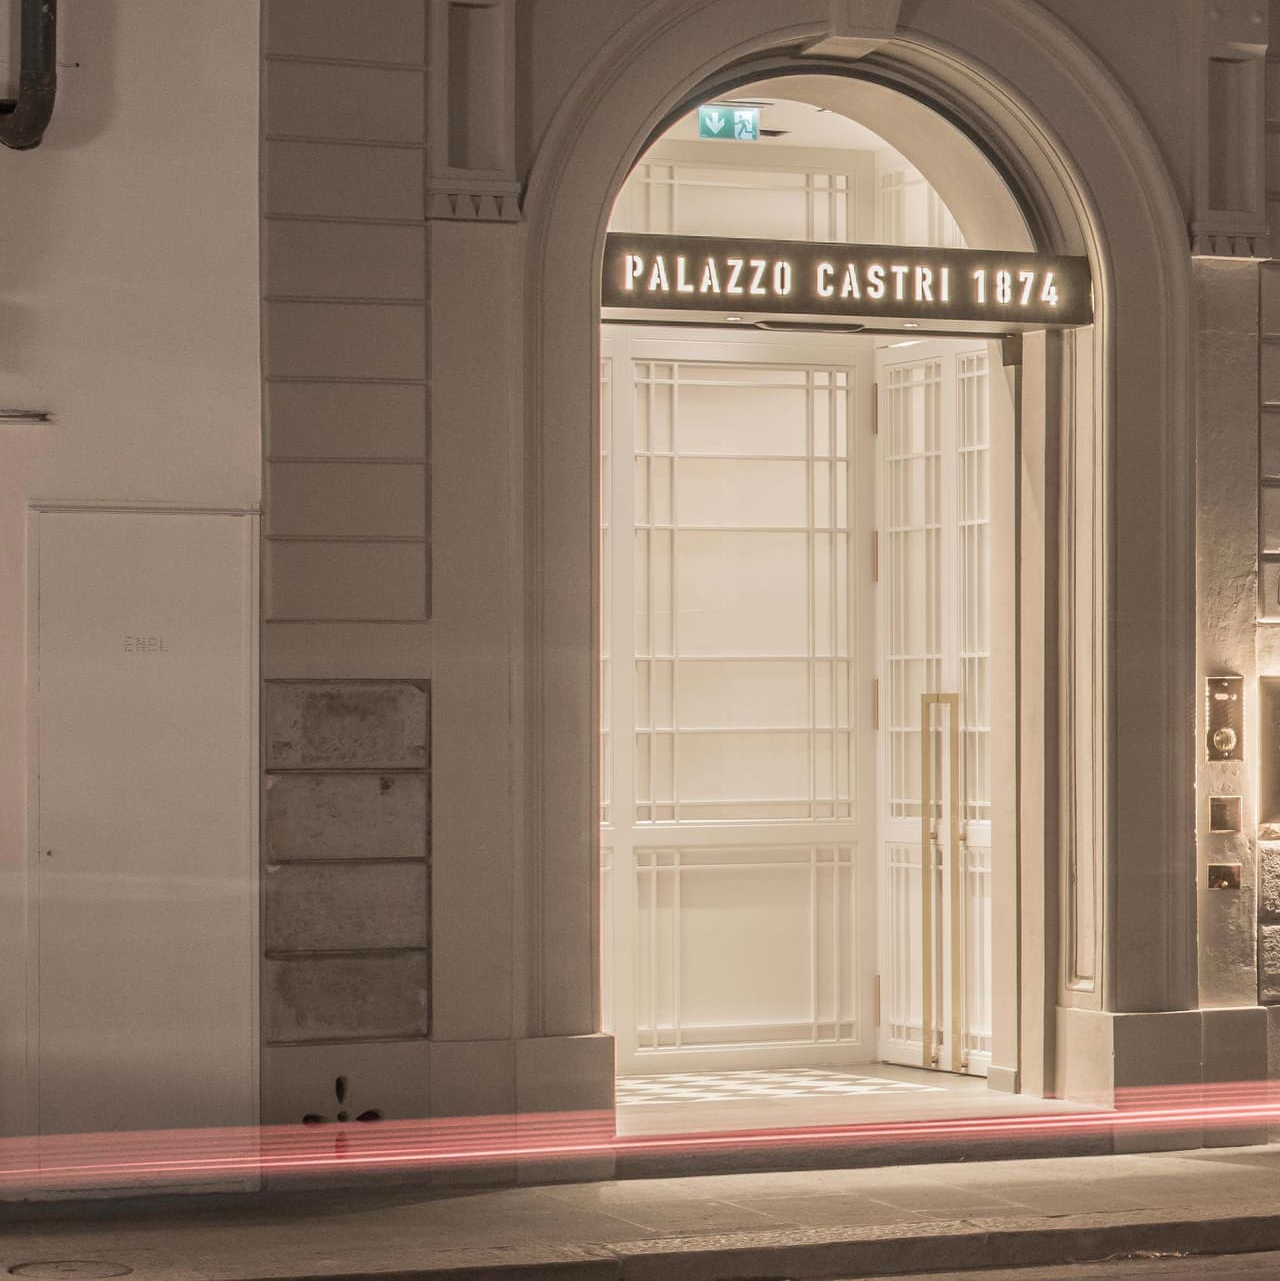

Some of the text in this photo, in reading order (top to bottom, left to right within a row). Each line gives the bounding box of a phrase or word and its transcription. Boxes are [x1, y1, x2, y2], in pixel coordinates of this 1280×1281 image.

[623, 254, 1060, 306] PALAZZO CASTRI 1874
